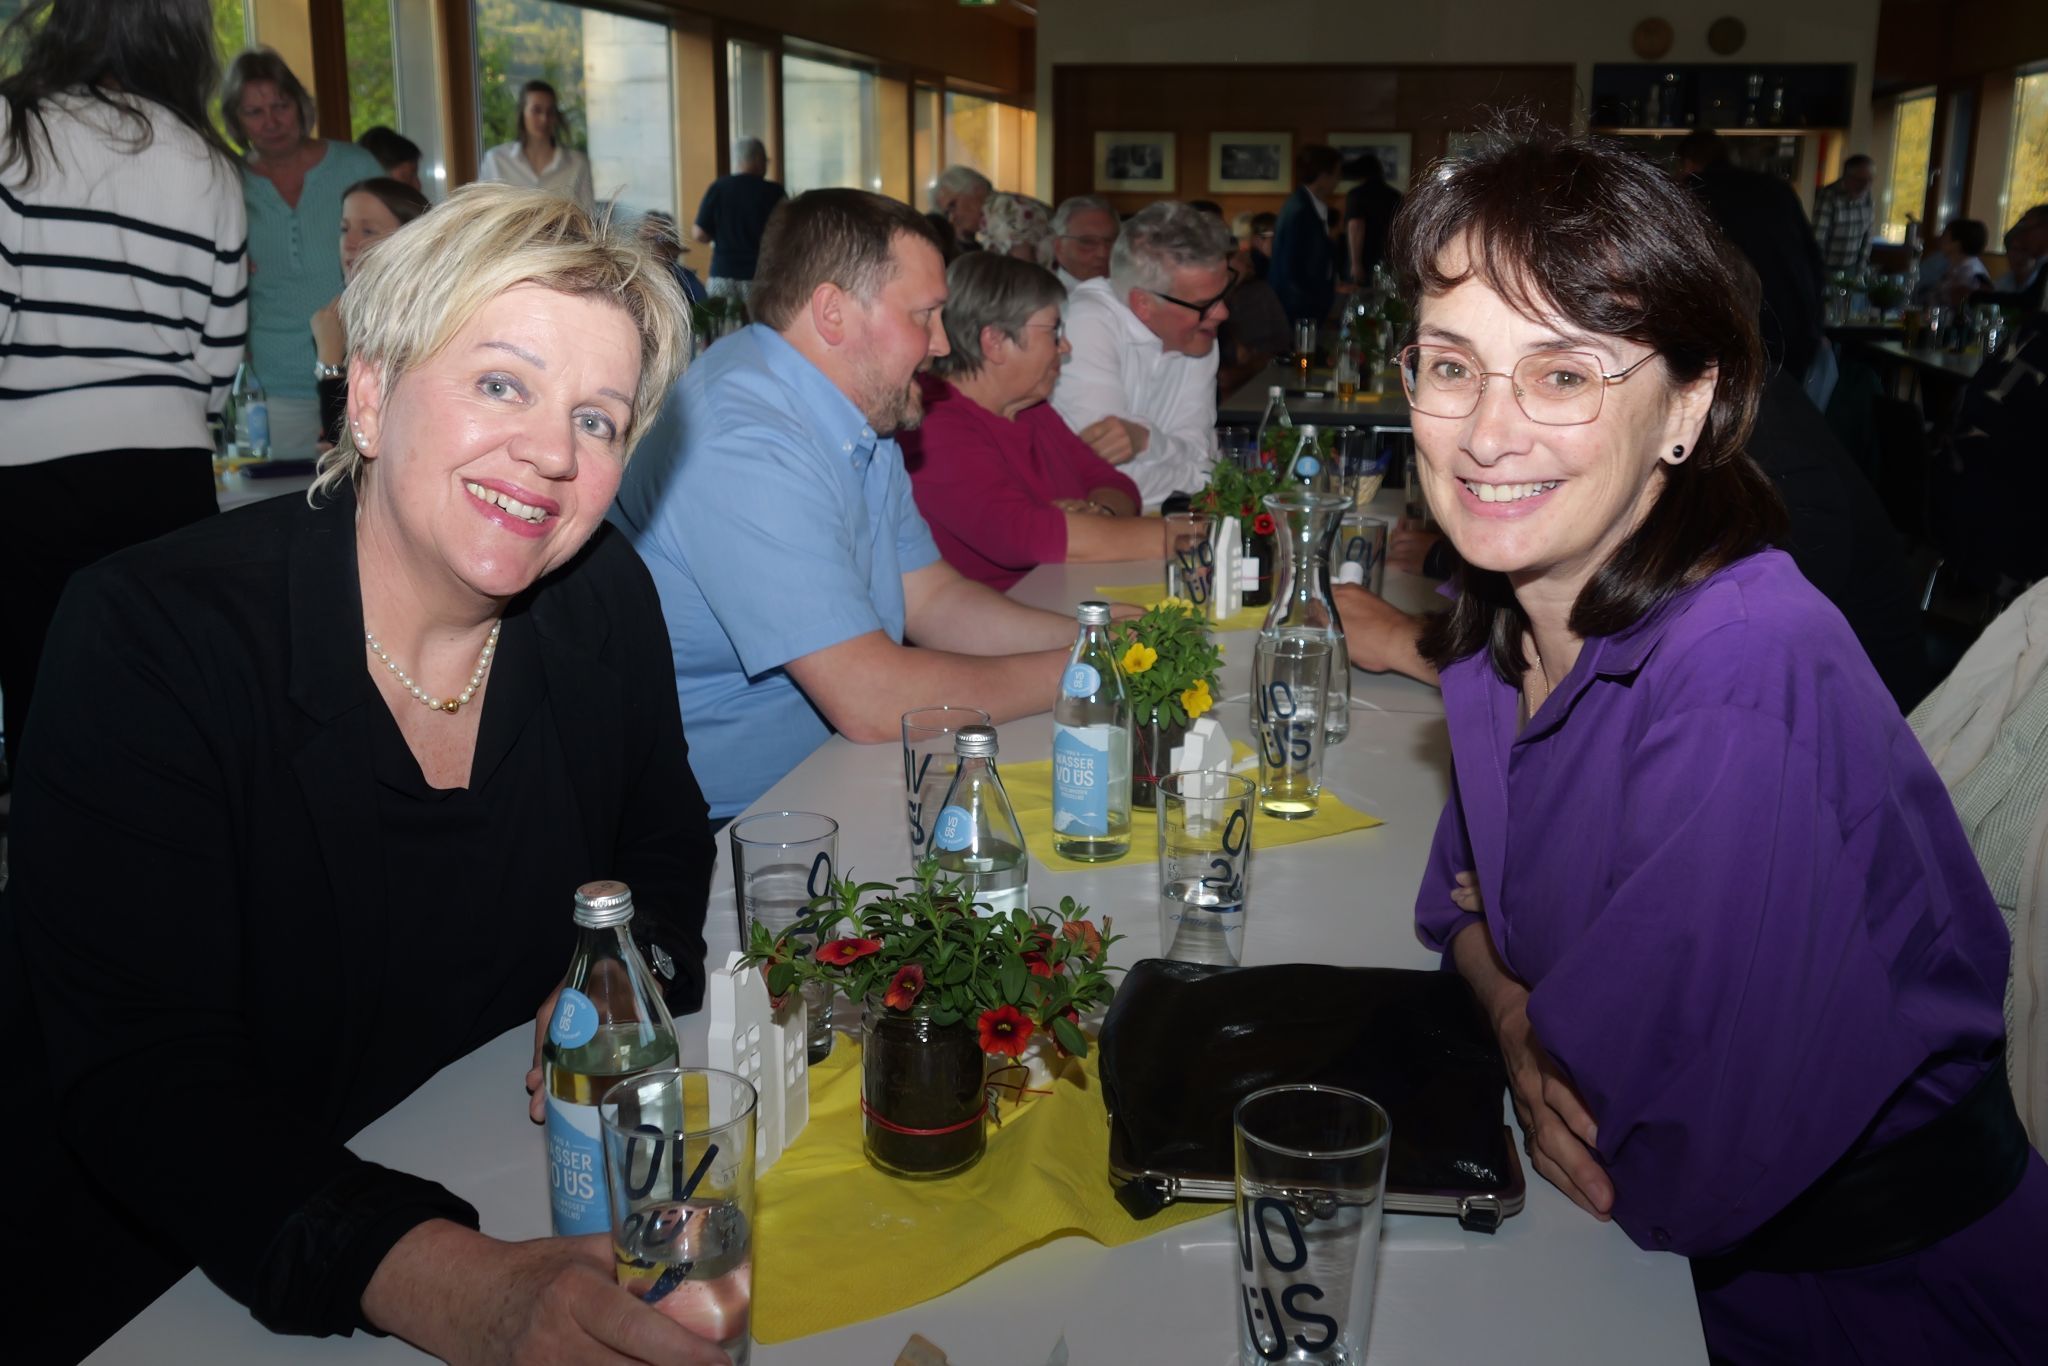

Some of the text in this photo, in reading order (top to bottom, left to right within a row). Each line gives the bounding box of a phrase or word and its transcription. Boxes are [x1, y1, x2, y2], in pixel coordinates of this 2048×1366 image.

[1056, 751, 1094, 770] WASSER
[1056, 764, 1094, 787] VO ÜS
[549, 1141, 593, 1171] ASSER
[563, 1168, 594, 1200] ÜS
[1242, 1282, 1339, 1362] ÜS
